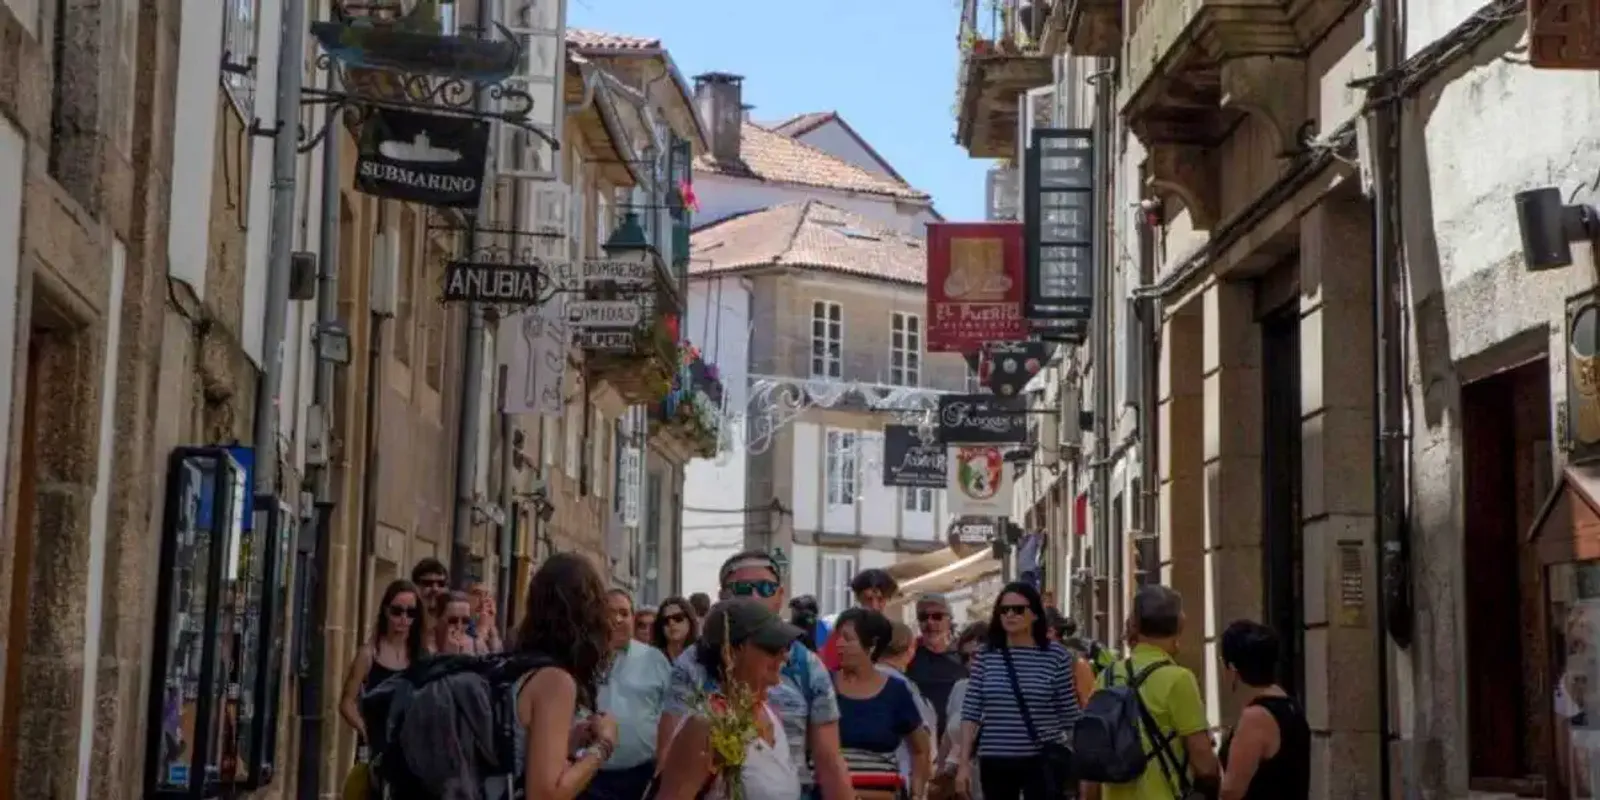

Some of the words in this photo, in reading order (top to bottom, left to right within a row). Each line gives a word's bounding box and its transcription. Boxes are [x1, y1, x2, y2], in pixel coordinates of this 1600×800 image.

[360, 160, 477, 193] SUBMARINO
[448, 266, 535, 298] ANUBIA
[567, 305, 636, 322] COMIDAS
[936, 303, 955, 321] EL
